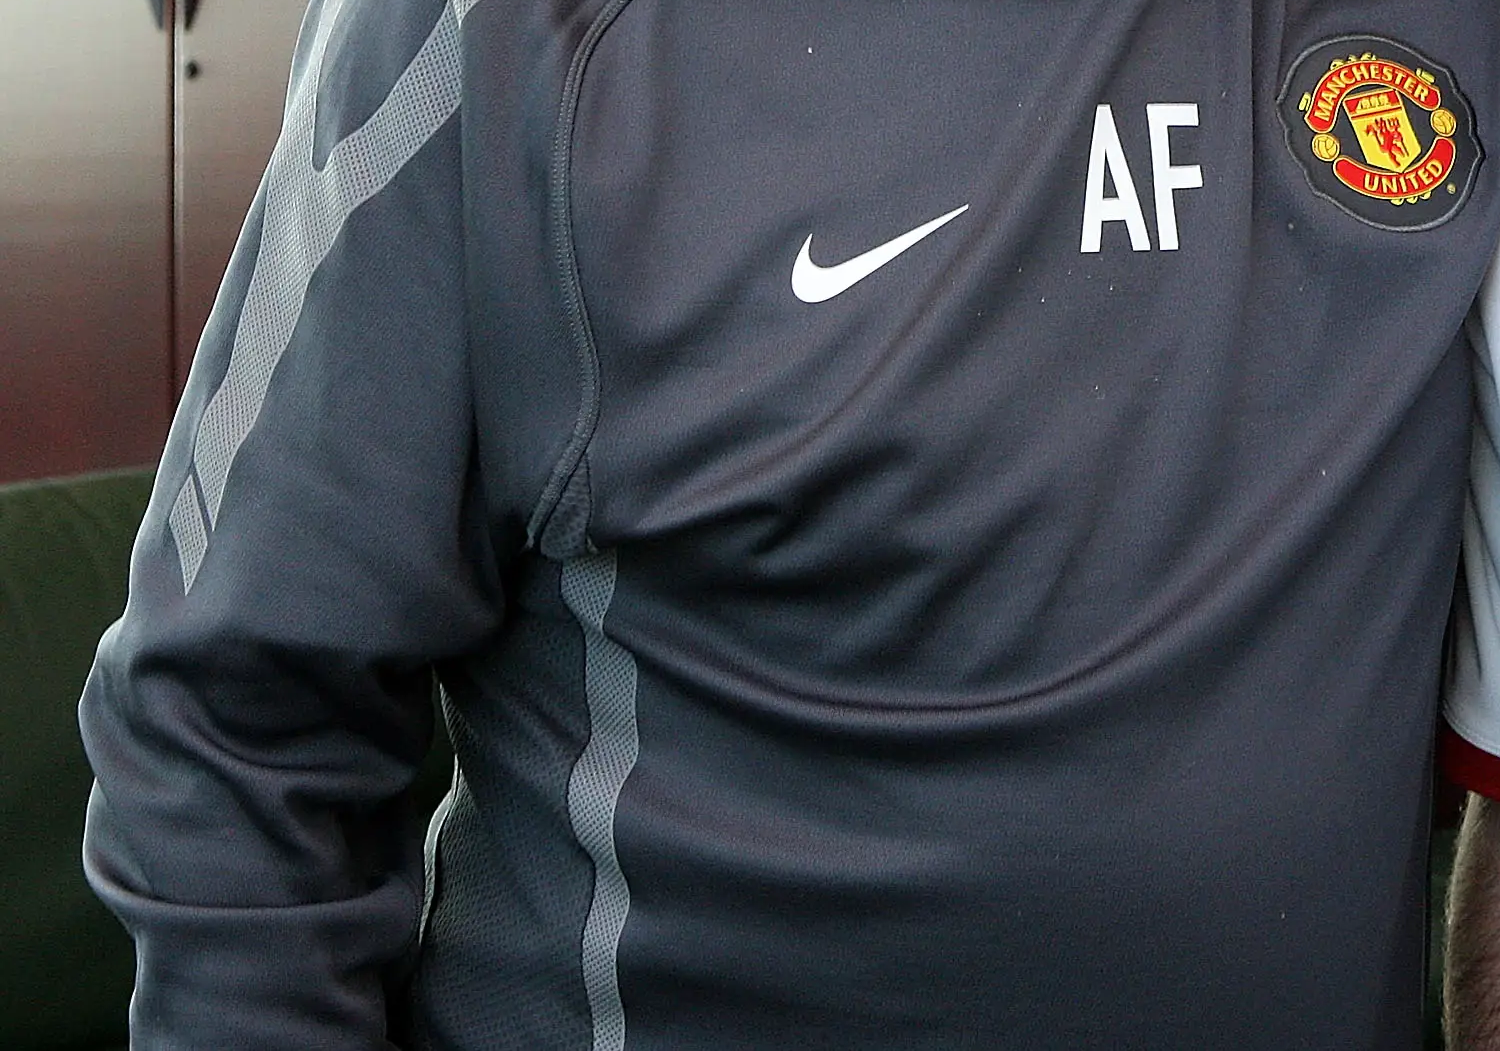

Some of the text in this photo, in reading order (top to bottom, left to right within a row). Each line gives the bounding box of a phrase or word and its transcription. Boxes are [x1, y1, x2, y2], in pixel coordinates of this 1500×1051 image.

[1314, 63, 1431, 122] MANCHESTER
[1080, 103, 1203, 253] AF
[1363, 161, 1443, 194] UNITED
